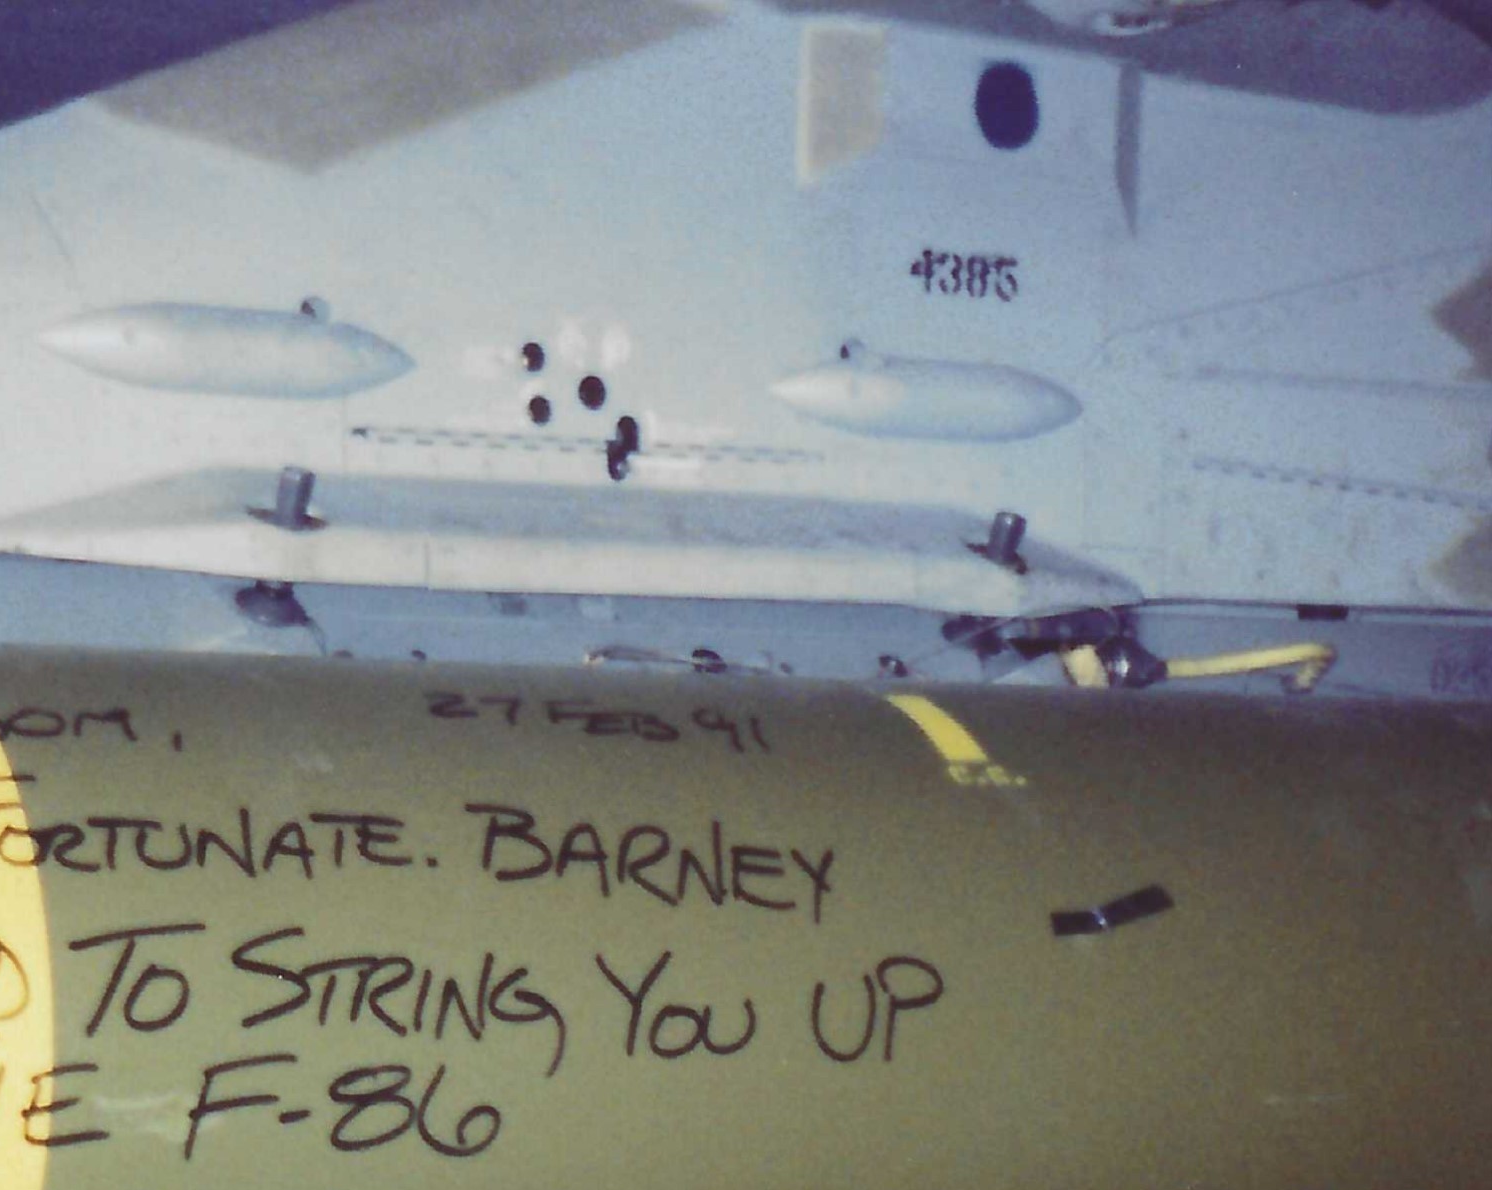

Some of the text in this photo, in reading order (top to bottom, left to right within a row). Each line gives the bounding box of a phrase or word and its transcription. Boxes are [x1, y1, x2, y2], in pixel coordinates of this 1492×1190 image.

[910, 249, 1018, 302] 4385
[423, 692, 771, 752] 27 FEB 91
[465, 803, 835, 923] BARNEY
[68, 923, 205, 1036] TO
[595, 951, 757, 1058] YOU
[812, 955, 945, 1064] UP
[184, 1053, 502, 1160] F-86
